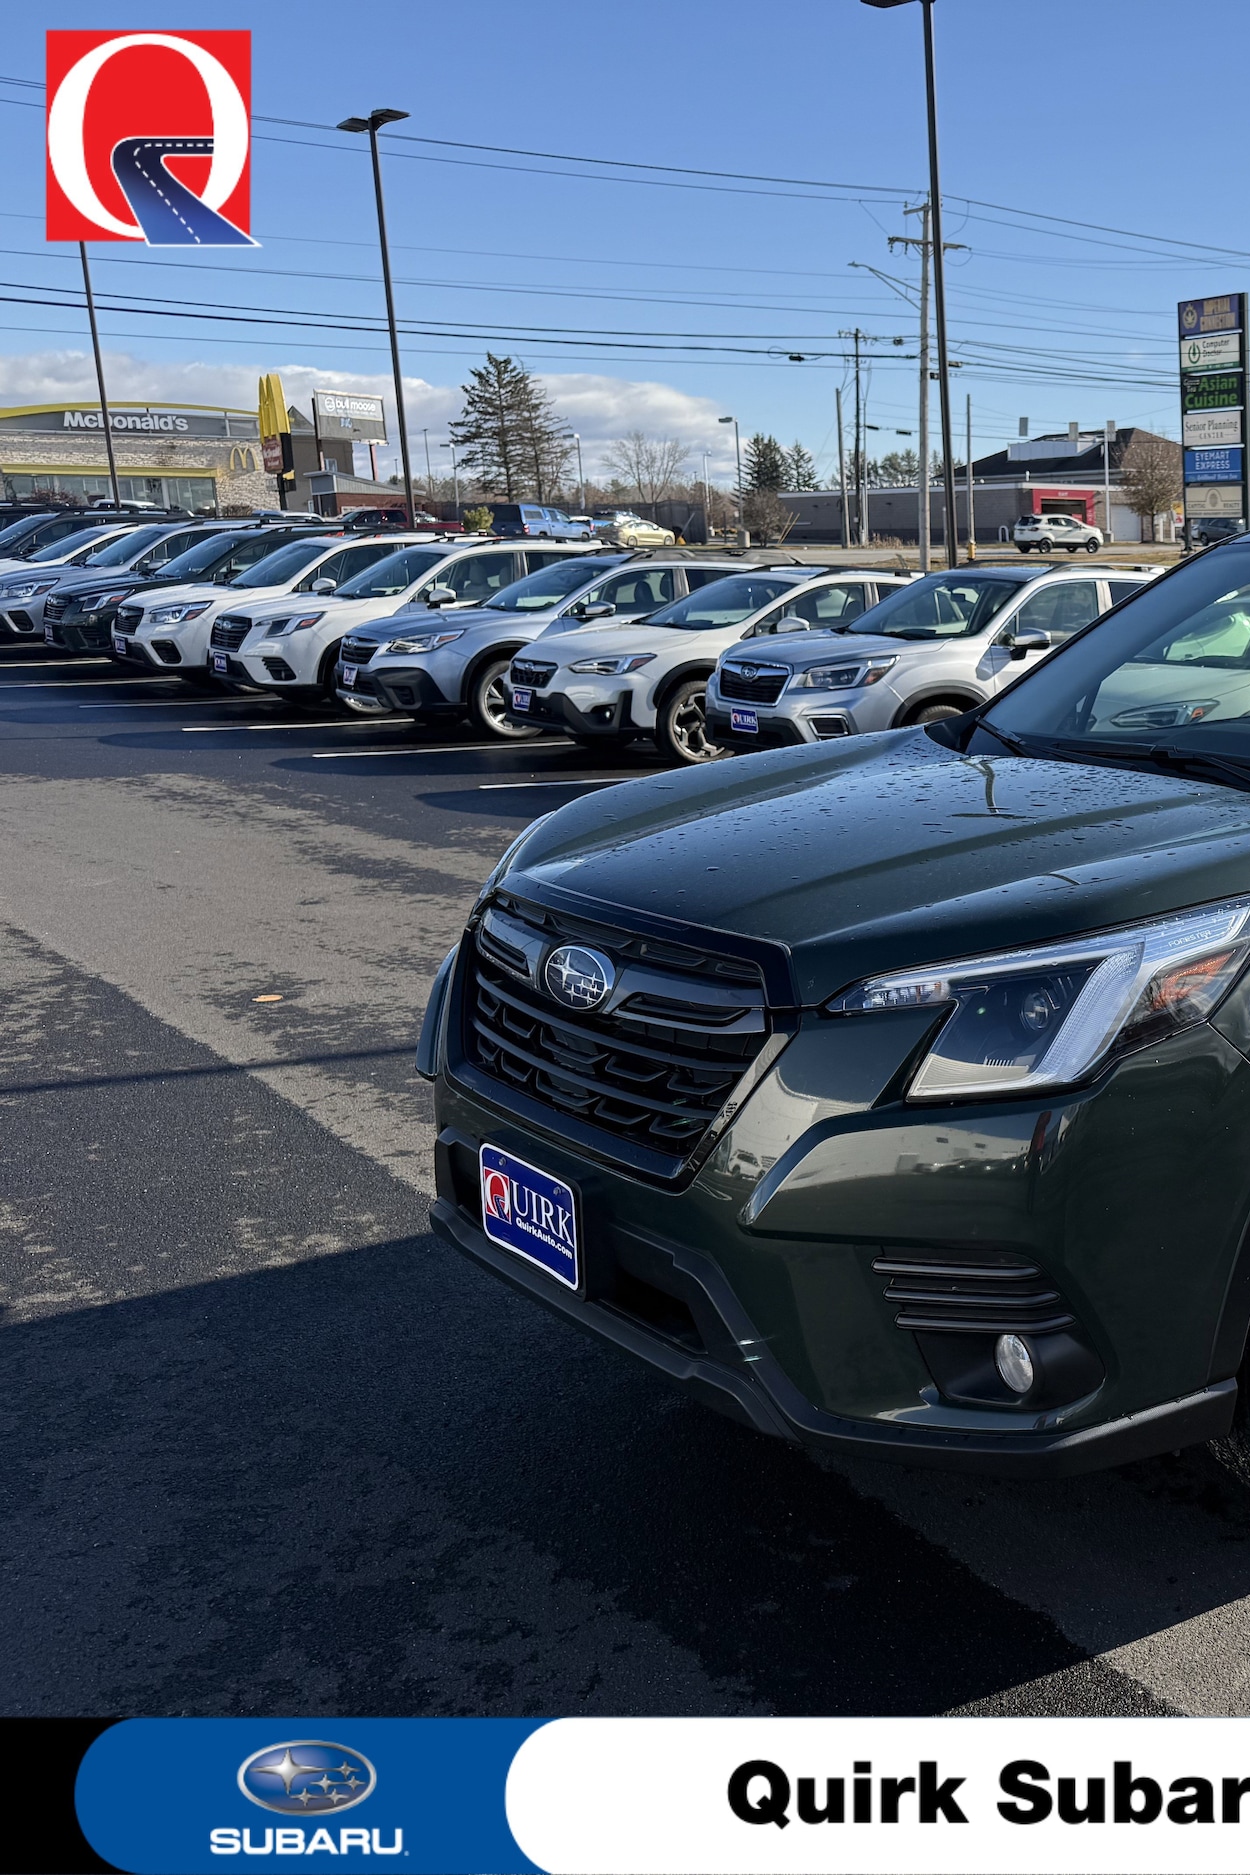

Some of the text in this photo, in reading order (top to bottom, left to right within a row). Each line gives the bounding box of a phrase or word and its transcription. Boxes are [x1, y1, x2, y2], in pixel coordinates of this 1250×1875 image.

[1202, 339, 1229, 349] Computer
[1198, 375, 1238, 392] Asian
[336, 399, 350, 409] bull
[350, 401, 376, 412] moose
[1184, 392, 1238, 409] Cuisine
[63, 411, 189, 431] McDonald's
[1185, 418, 1238, 432] Senior Planning
[1199, 432, 1224, 440] CENTER
[1195, 451, 1230, 461] EYEMART
[1195, 460, 1231, 471] EXPRESS
[1168, 929, 1212, 948] FORESTER
[484, 1172, 575, 1249] QUIRK
[515, 1216, 573, 1260] QuirkAuto.com
